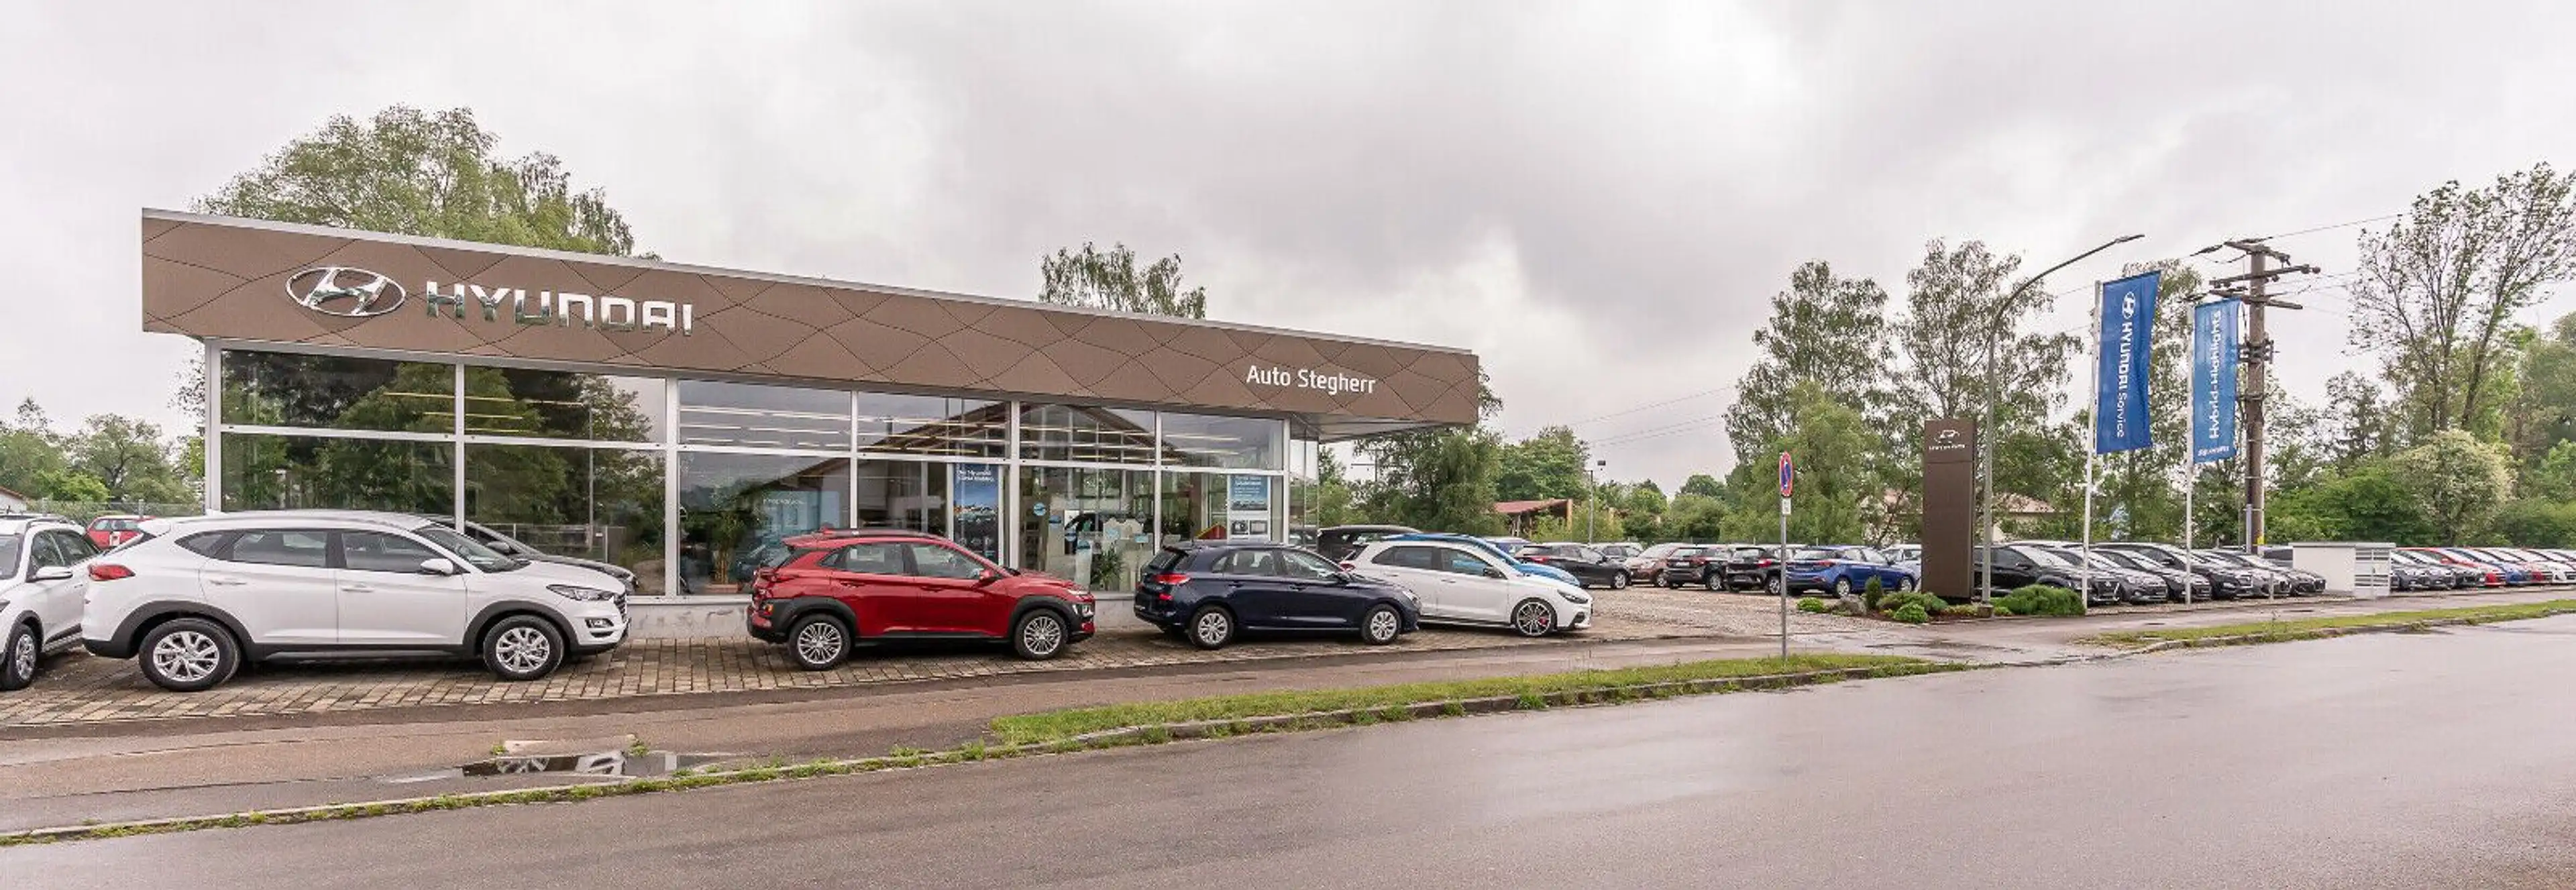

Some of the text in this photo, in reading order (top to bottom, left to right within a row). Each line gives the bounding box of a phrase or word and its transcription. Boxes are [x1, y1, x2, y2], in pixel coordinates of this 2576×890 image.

[427, 281, 692, 337] HYUNDAI
[1246, 365, 1377, 395] Auto Stegherr
[2117, 322, 2133, 438] HYUNDAI Service
